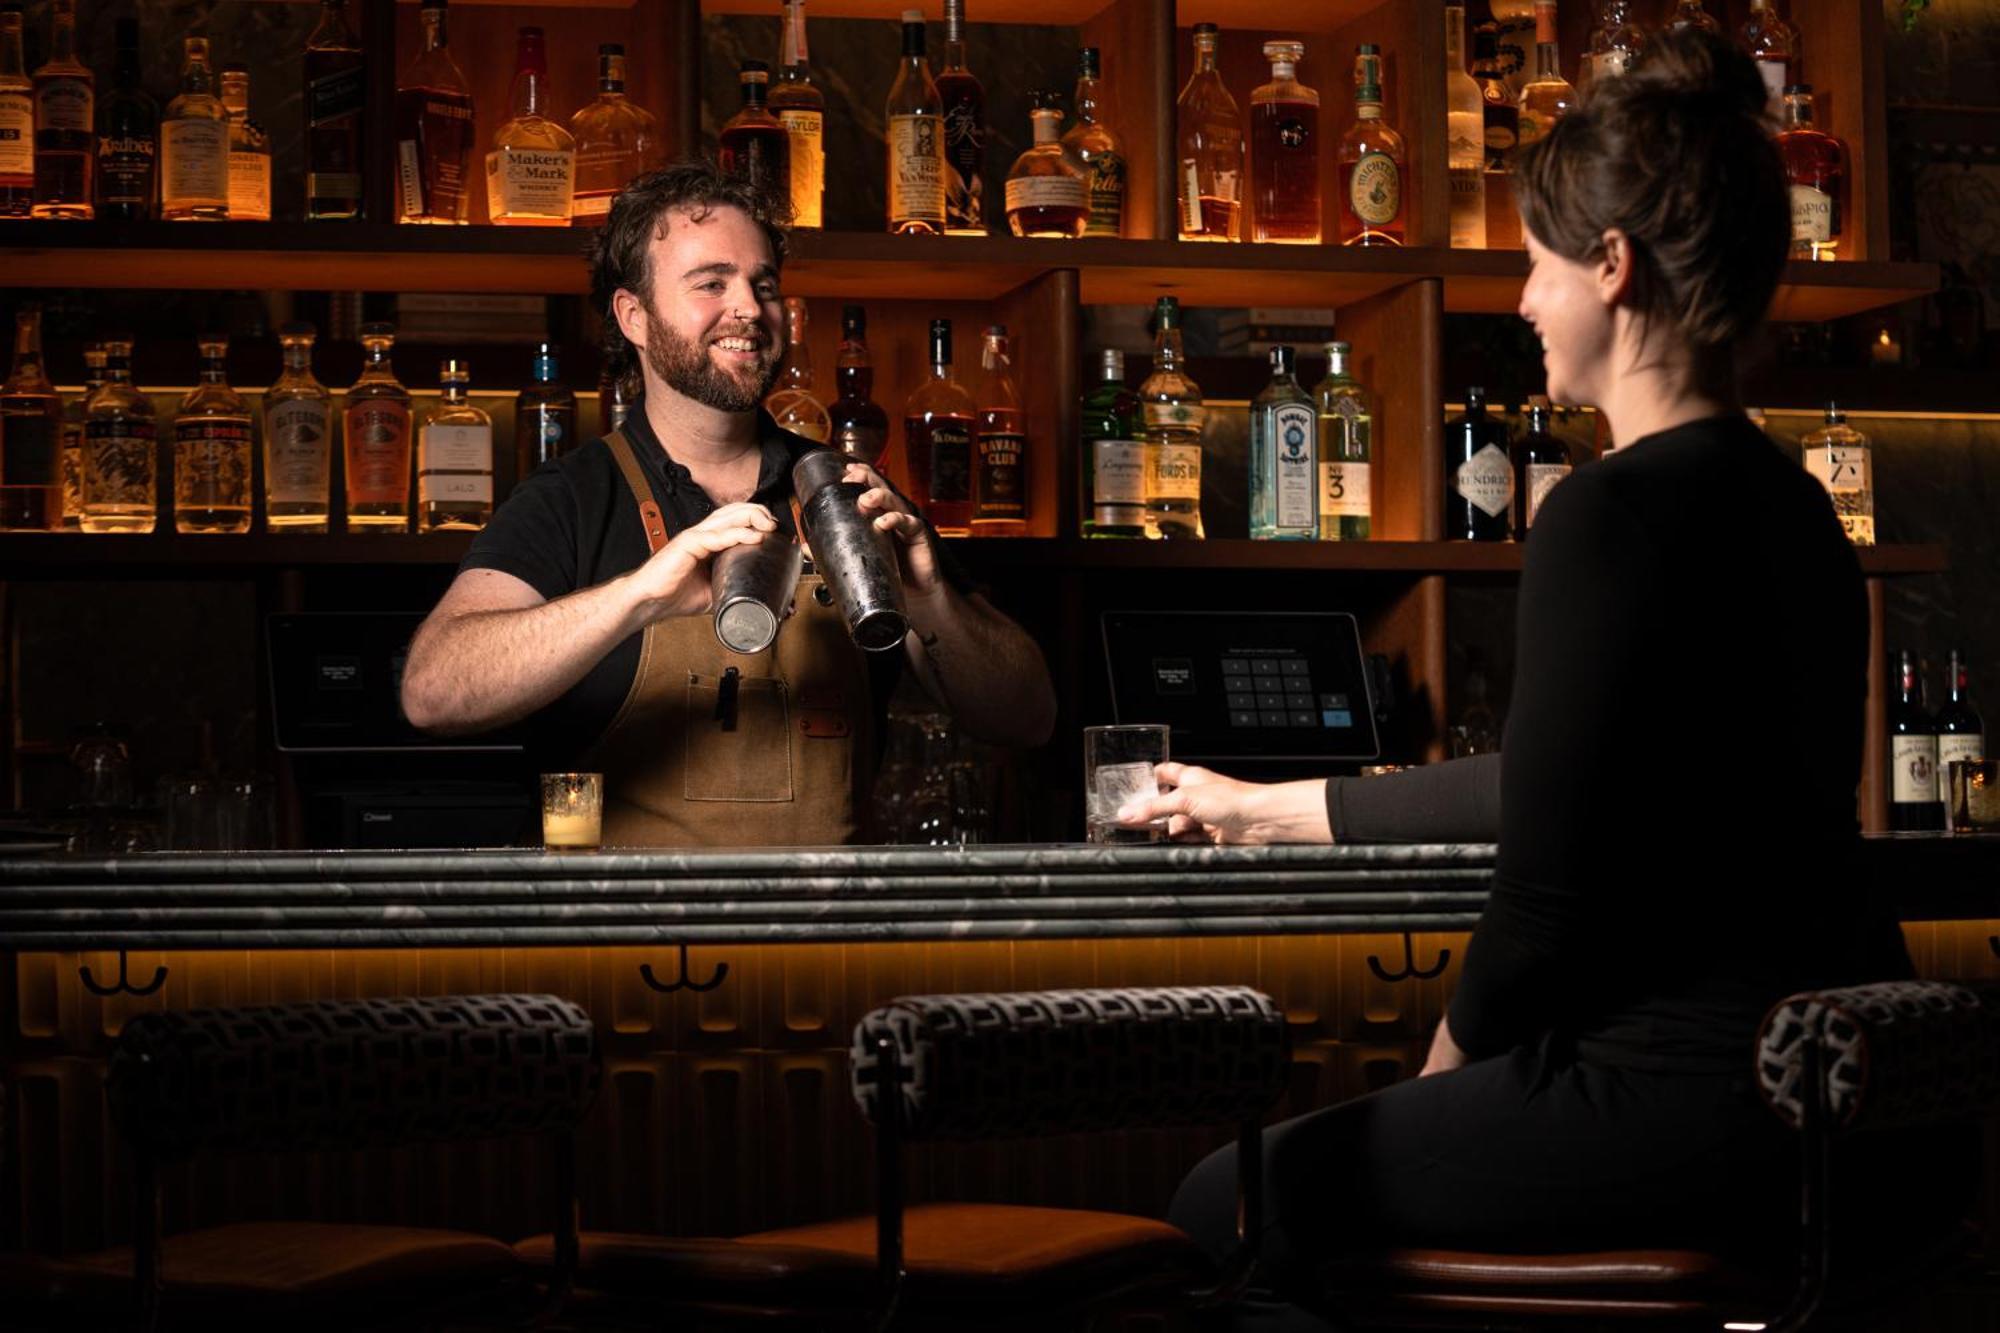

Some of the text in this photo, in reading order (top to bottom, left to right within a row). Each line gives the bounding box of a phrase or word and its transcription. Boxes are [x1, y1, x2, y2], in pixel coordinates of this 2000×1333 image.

[509, 154, 567, 166] Maker's
[526, 167, 567, 179] Mark
[988, 453, 1016, 465] CLUB
[1329, 475, 1344, 499] 3
